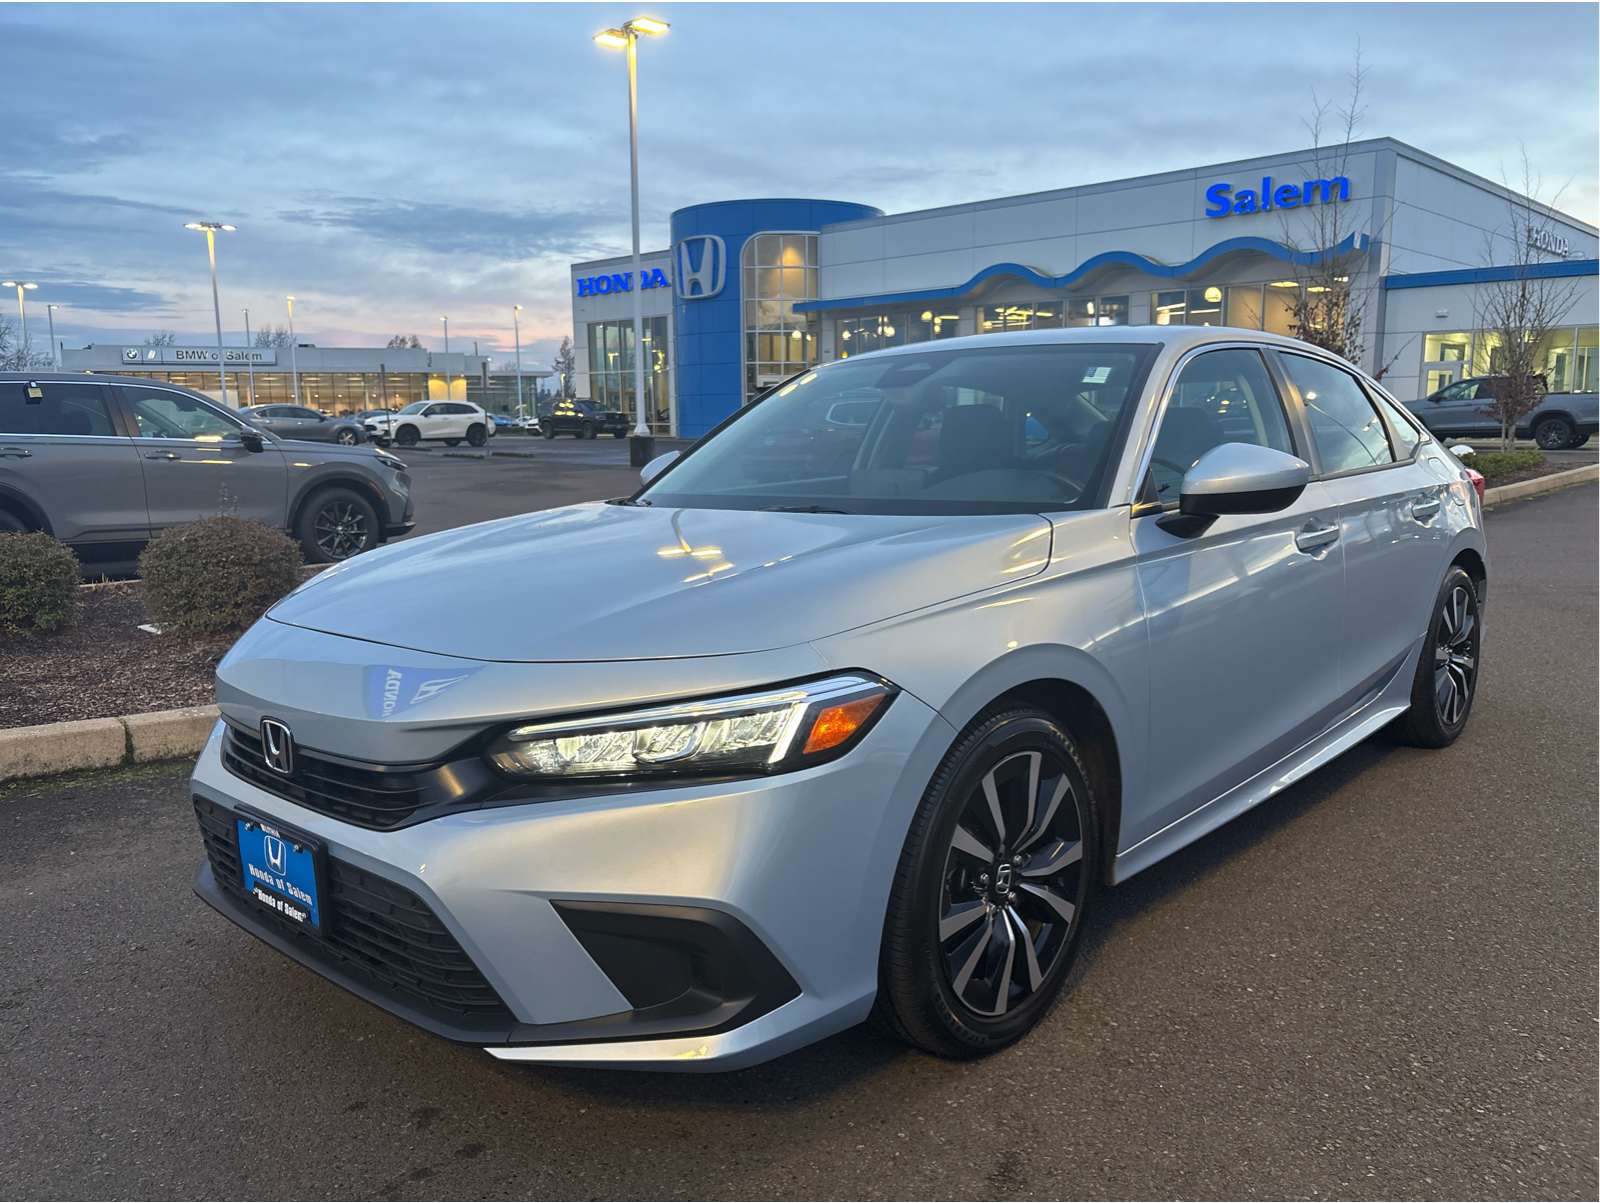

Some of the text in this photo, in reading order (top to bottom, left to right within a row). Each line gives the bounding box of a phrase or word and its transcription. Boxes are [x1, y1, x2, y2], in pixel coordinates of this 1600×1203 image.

[1205, 176, 1349, 218] Salem
[176, 350, 208, 360] BMW
[248, 863, 313, 906] Honda of Salem
[276, 900, 283, 912] of
